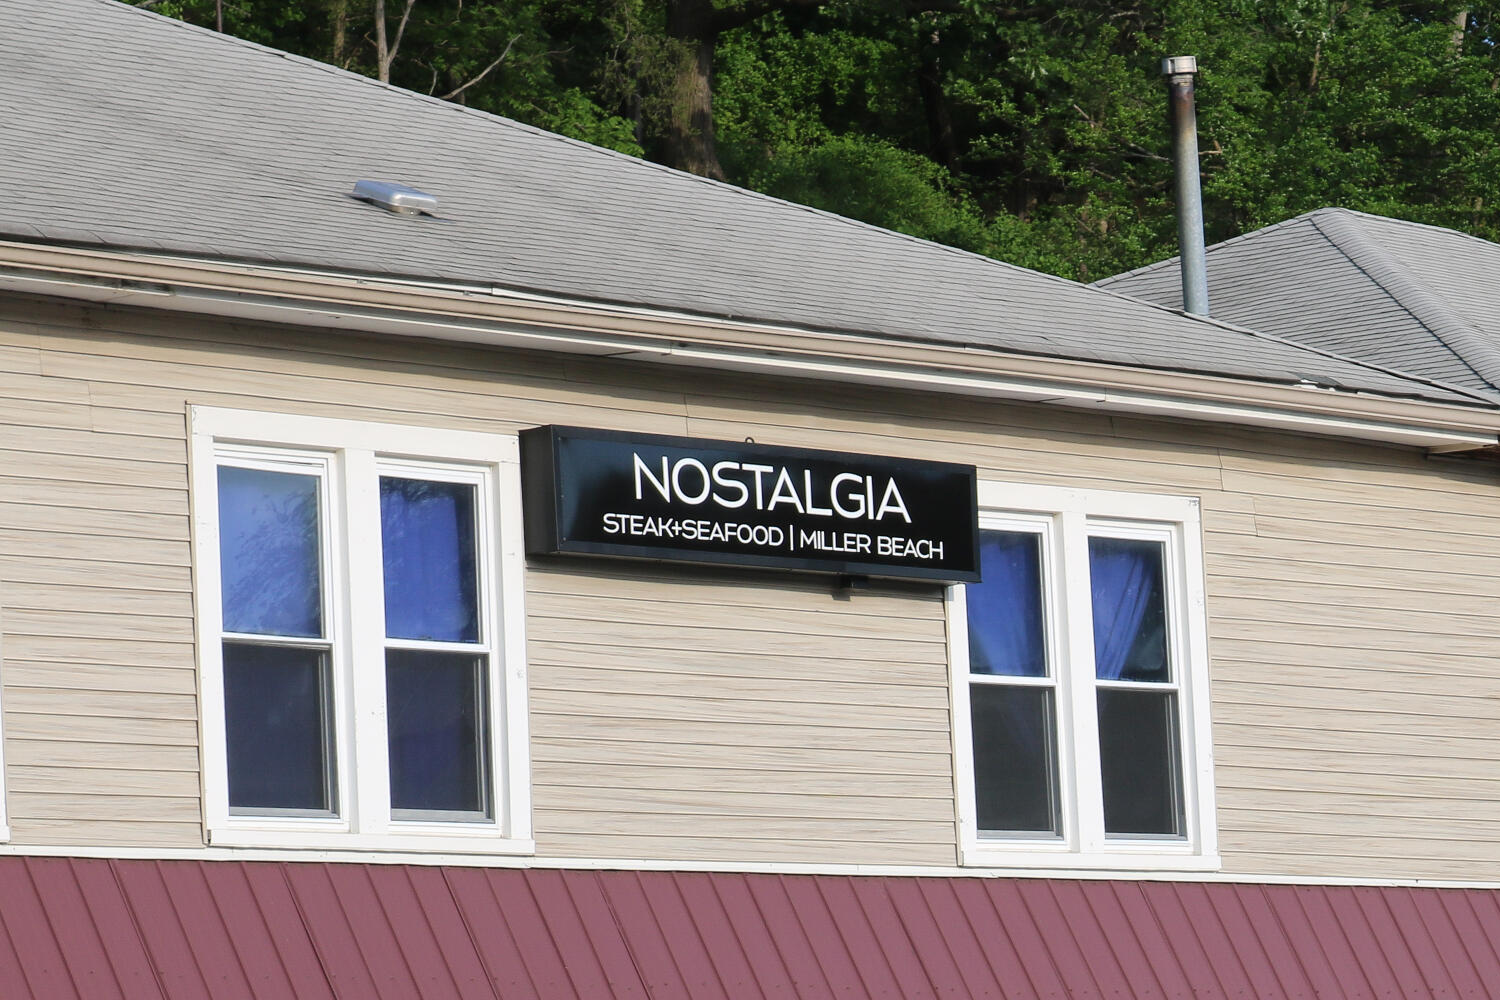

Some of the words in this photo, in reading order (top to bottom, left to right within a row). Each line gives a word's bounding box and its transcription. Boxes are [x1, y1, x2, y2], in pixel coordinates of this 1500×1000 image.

[632, 452, 912, 523] NOSTALGIA
[602, 512, 784, 546] STEAK+SEAFOOD
[800, 529, 871, 553] MILLER
[877, 535, 944, 560] BEACH
